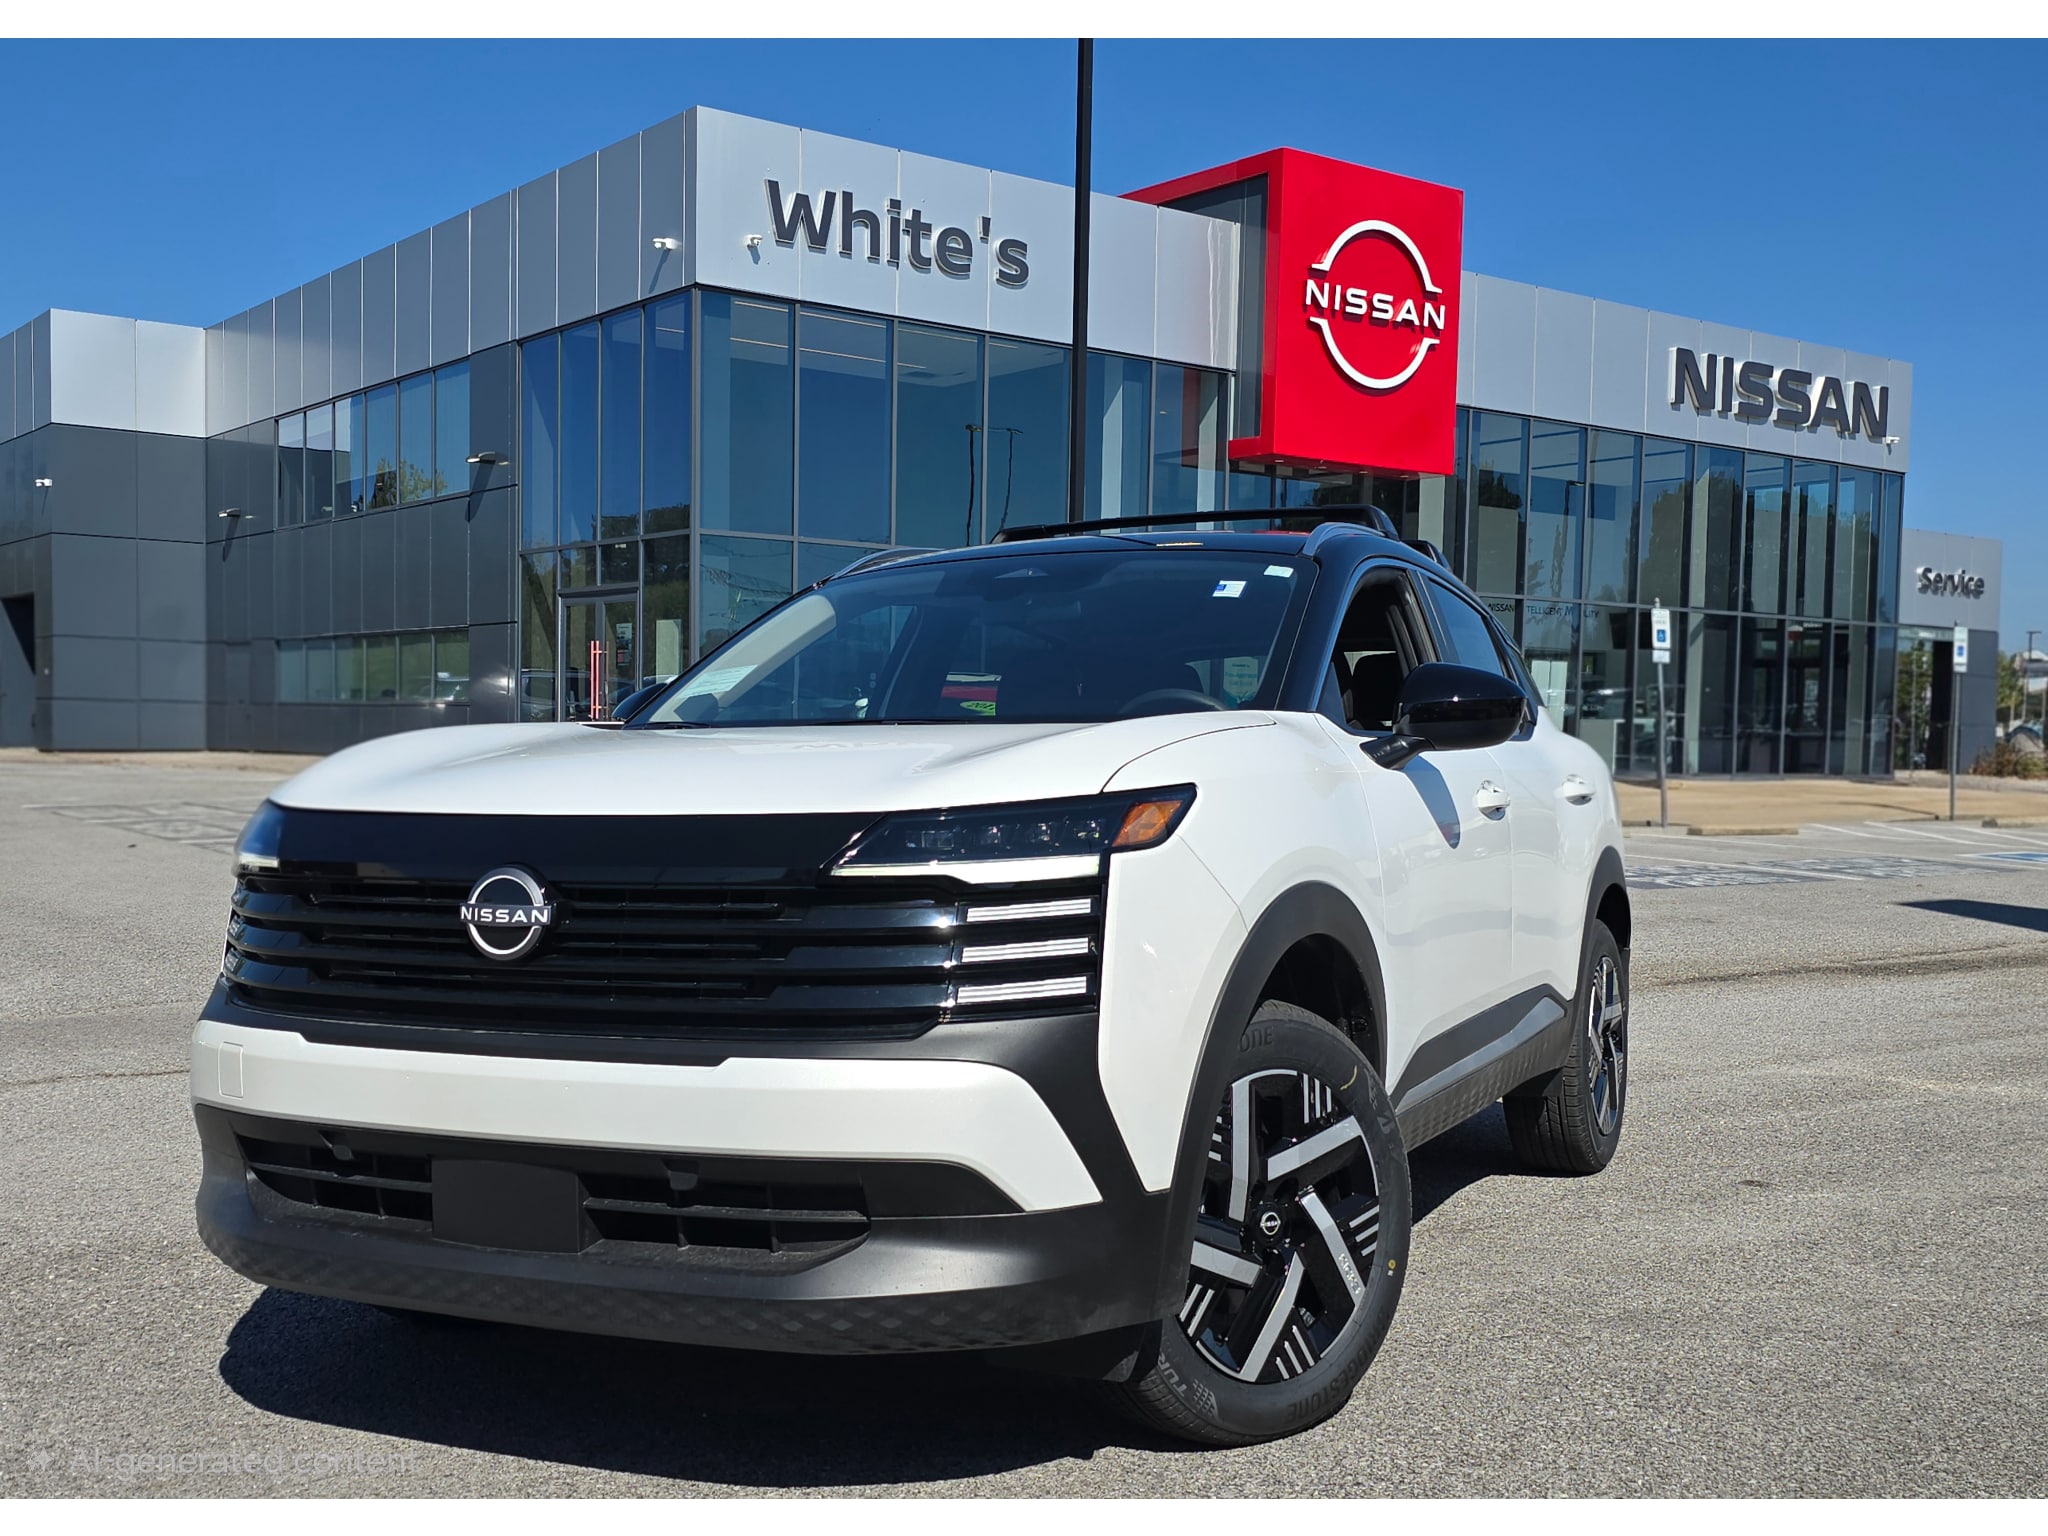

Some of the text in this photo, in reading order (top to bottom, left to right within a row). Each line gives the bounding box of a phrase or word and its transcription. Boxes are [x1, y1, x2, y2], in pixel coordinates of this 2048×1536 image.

[764, 179, 1030, 288] White's
[1305, 278, 1446, 330] NISSAN
[1669, 346, 1889, 438] NISSAN
[1916, 567, 1985, 597] Service
[460, 906, 549, 923] NISSAN
